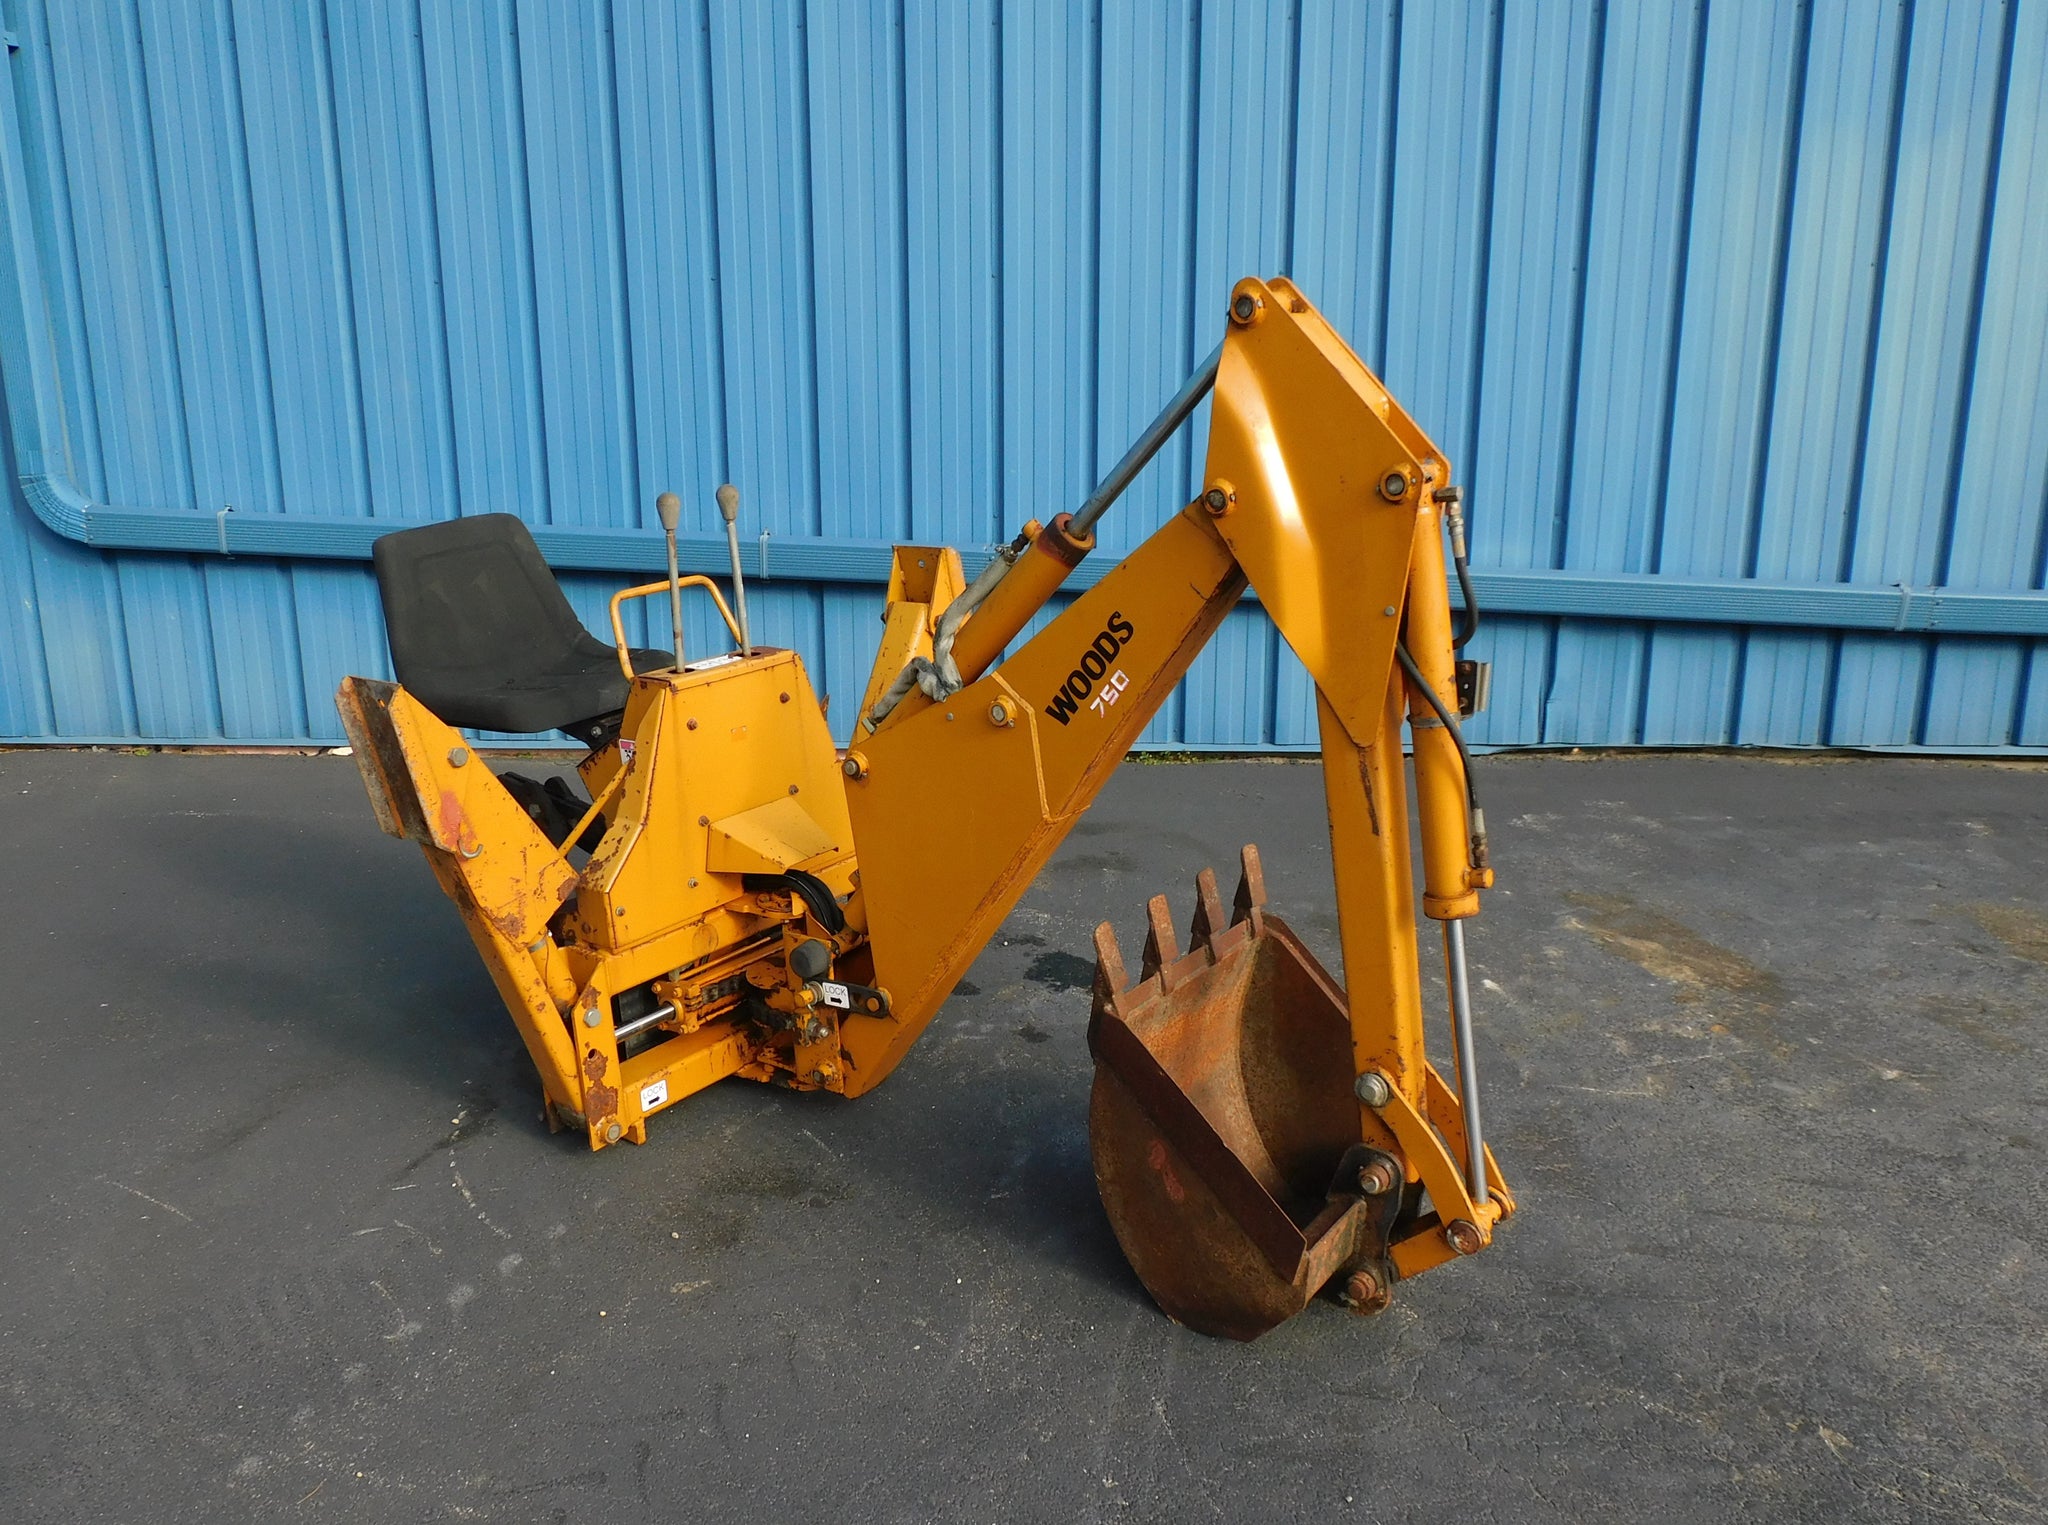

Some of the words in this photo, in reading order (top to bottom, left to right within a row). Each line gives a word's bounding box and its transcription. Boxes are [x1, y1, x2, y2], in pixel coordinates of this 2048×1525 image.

[1045, 611, 1134, 726] WOODS
[1090, 669, 1130, 719] 750
[824, 985, 846, 997] LOCK
[642, 1083, 664, 1100] LOCK
